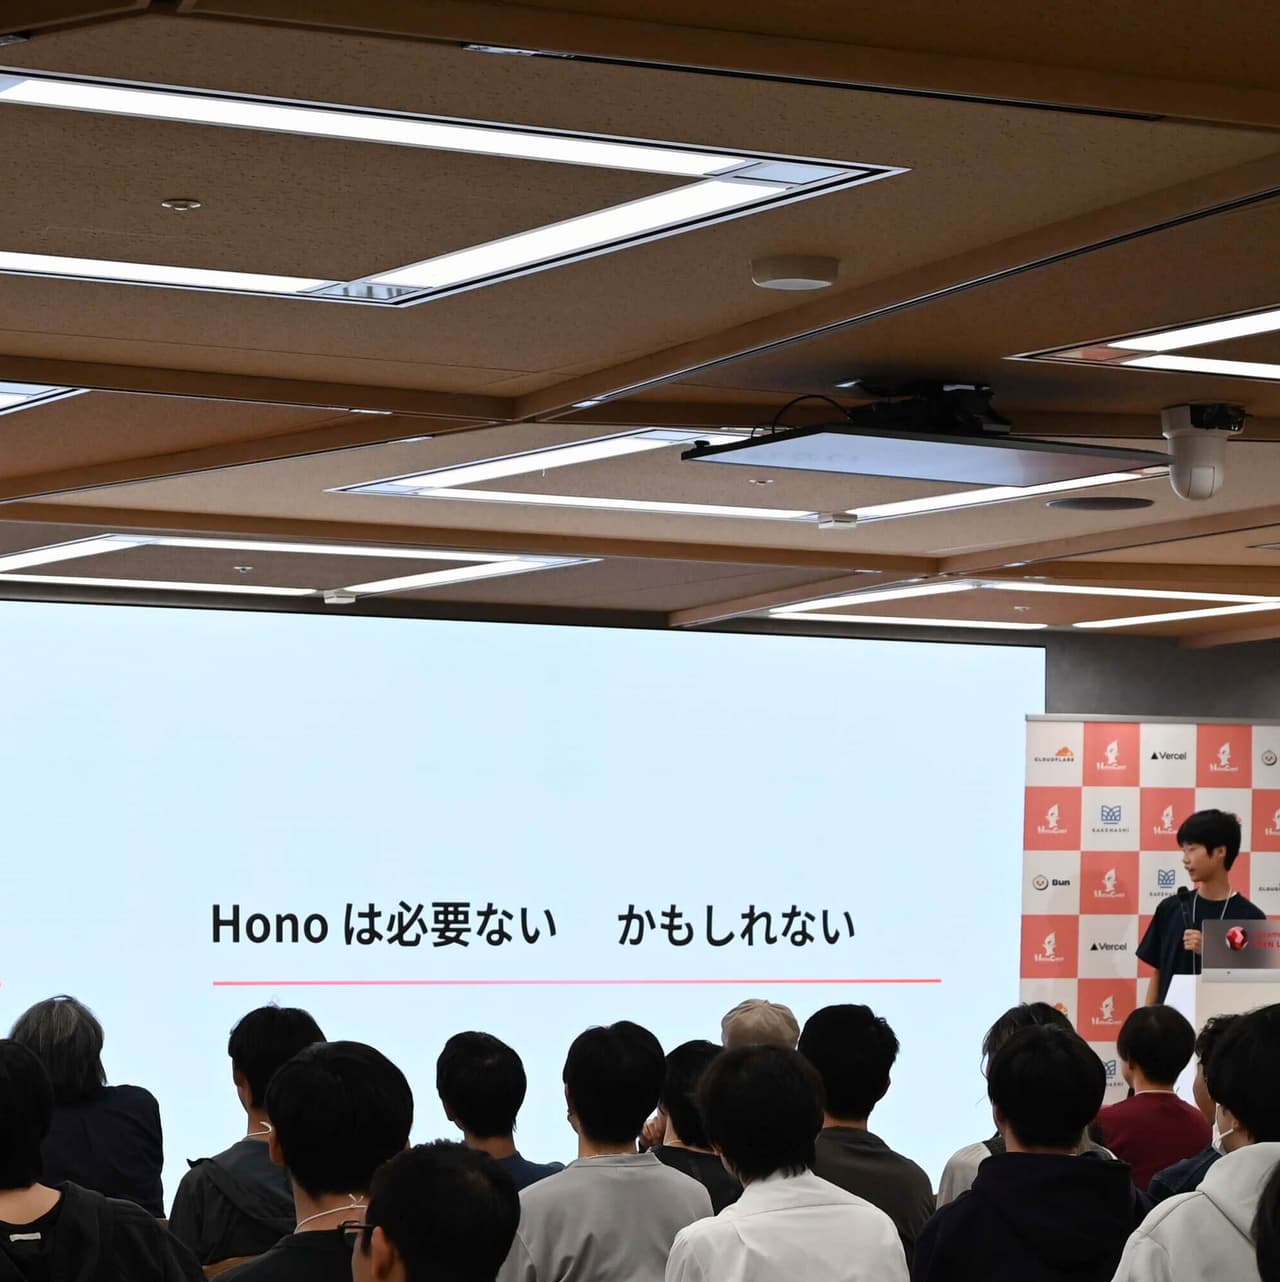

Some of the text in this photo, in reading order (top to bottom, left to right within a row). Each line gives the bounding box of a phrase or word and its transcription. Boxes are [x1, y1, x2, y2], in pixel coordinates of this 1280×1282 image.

[1159, 752, 1187, 761] Vercel
[1052, 878, 1070, 886] Bun
[213, 900, 855, 948] Hono は必要ない かもしれない
[1098, 942, 1127, 951] Vercel
